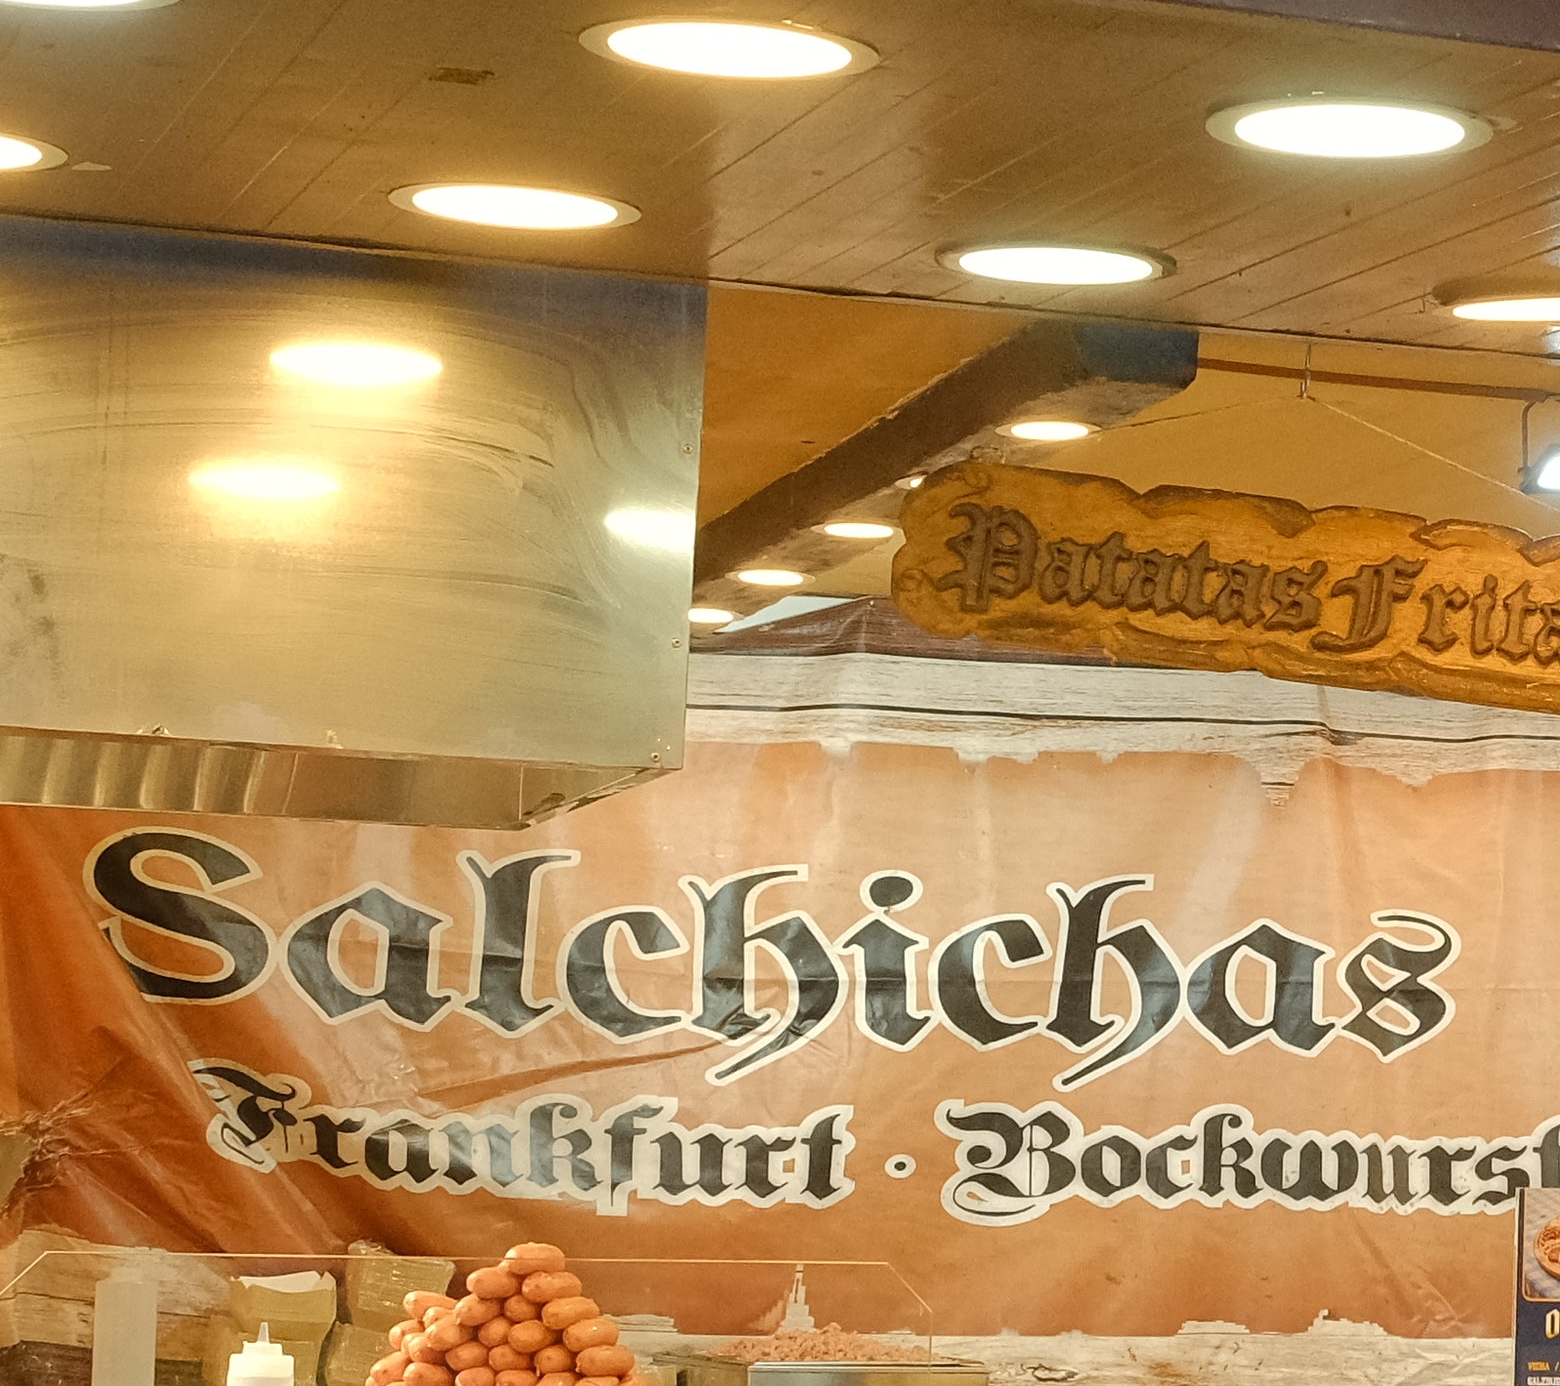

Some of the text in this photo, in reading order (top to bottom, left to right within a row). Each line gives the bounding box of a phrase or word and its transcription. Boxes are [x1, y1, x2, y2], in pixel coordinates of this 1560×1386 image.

[934, 501, 1330, 632] Patatas
[85, 828, 1458, 1091] Salchichas
[192, 1061, 852, 1215] Frankfurt
